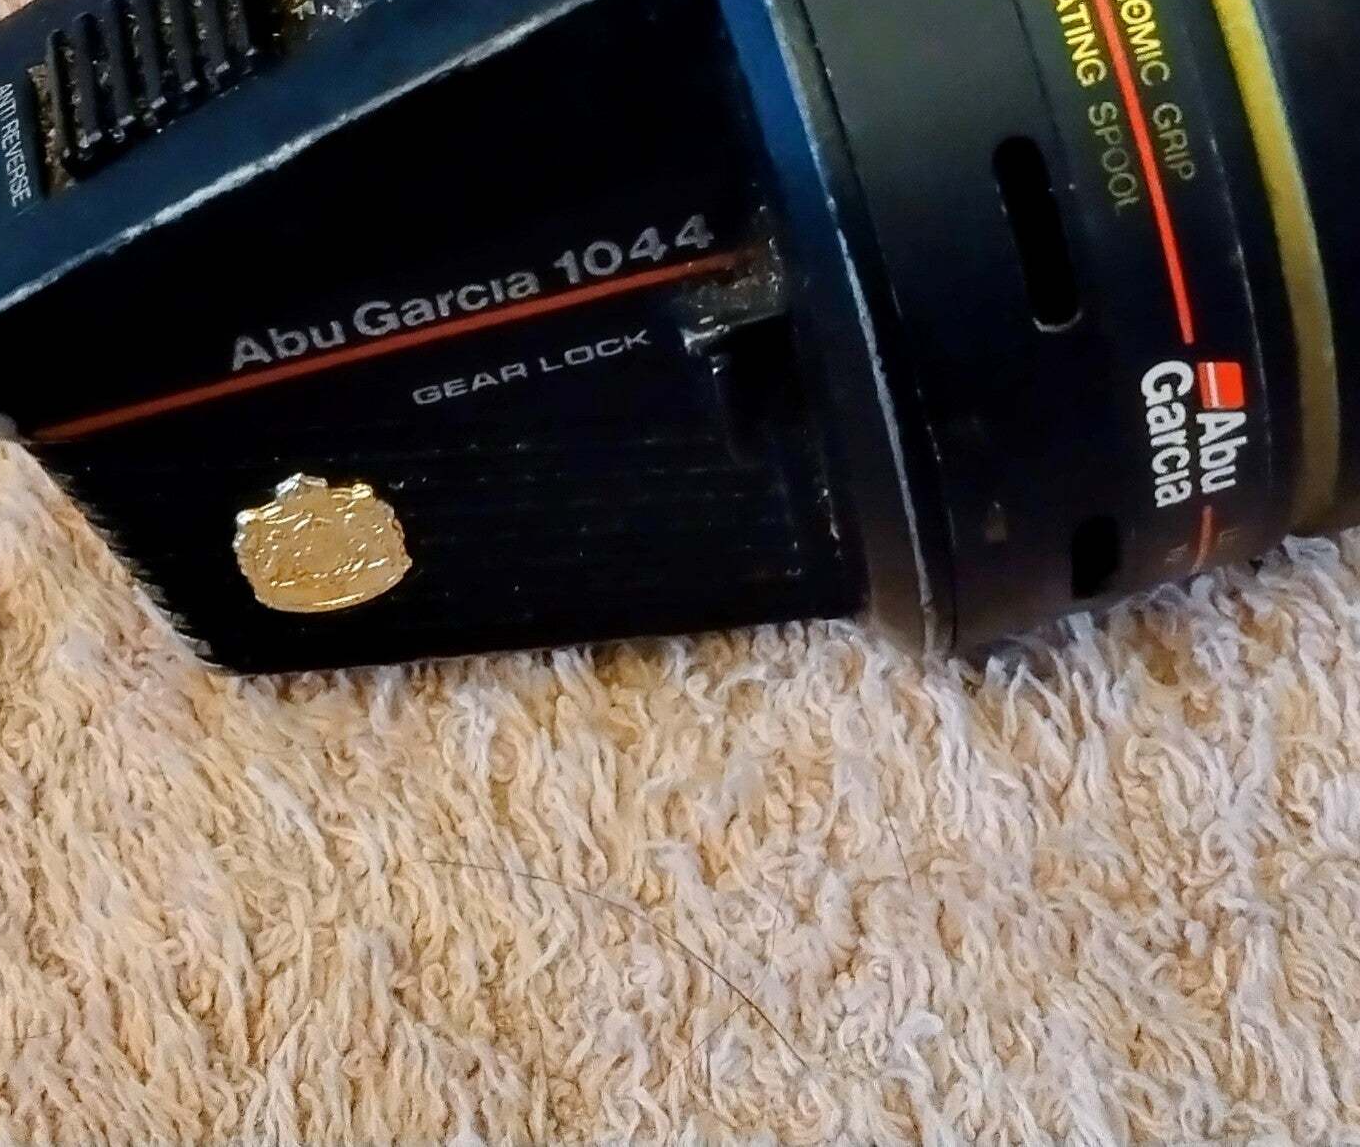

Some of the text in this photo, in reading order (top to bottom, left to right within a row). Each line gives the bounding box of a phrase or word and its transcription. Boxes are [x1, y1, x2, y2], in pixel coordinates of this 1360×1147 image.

[1, 118, 32, 207] REVERSE
[1152, 103, 1196, 180] GRIP
[231, 214, 715, 371] Abu Garcia 1044
[412, 329, 651, 405] GEAR LOCK
[1141, 360, 1194, 508] Garcia
[1196, 411, 1248, 495] Abu
